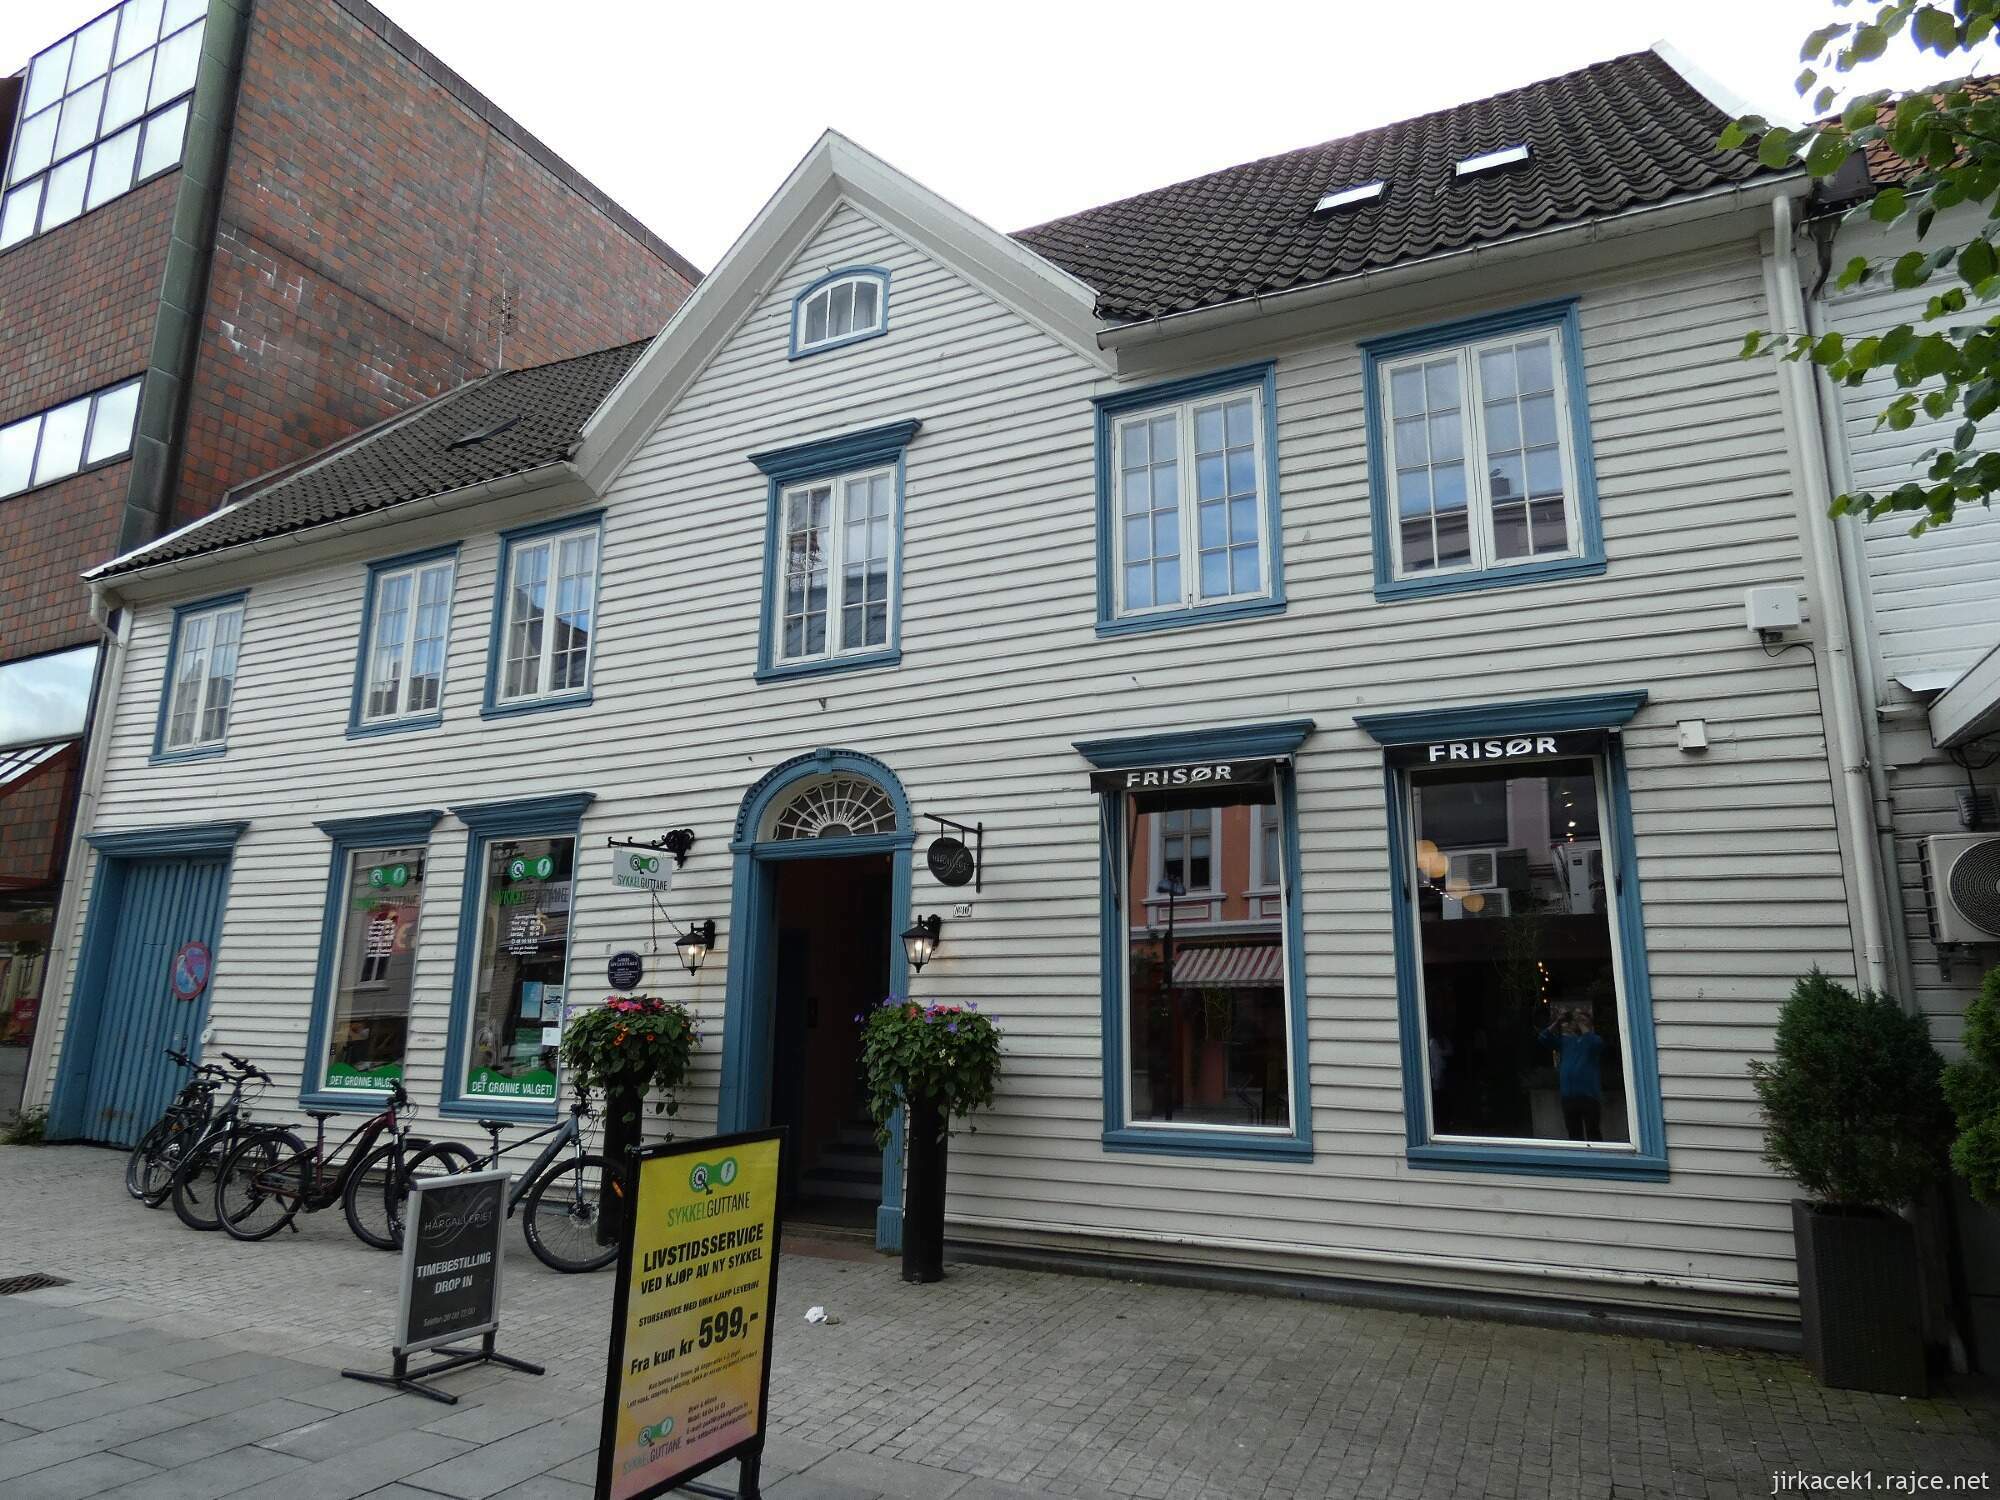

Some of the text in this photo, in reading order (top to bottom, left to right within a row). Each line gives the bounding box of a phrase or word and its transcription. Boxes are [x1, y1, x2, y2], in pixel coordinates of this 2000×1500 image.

[1429, 736, 1558, 762] FRISØR
[1126, 765, 1232, 788] FRISØR
[329, 1075, 343, 1086] DET
[472, 1081, 553, 1096] DET GRØNNE VALGET!
[667, 1192, 751, 1228] SYKKELGUTTANE
[643, 1223, 764, 1273] LIVSTIDSSERVICE
[415, 1252, 492, 1278] TIMEBESTILLING
[641, 1247, 763, 1295] VED KJØP AV NY SYKKEL
[434, 1275, 473, 1295] DROP IN
[683, 1300, 697, 1314] MED
[630, 1356, 650, 1376] Fra
[654, 1347, 675, 1366] kun
[679, 1336, 695, 1356] kr
[698, 1306, 759, 1349] 599,-
